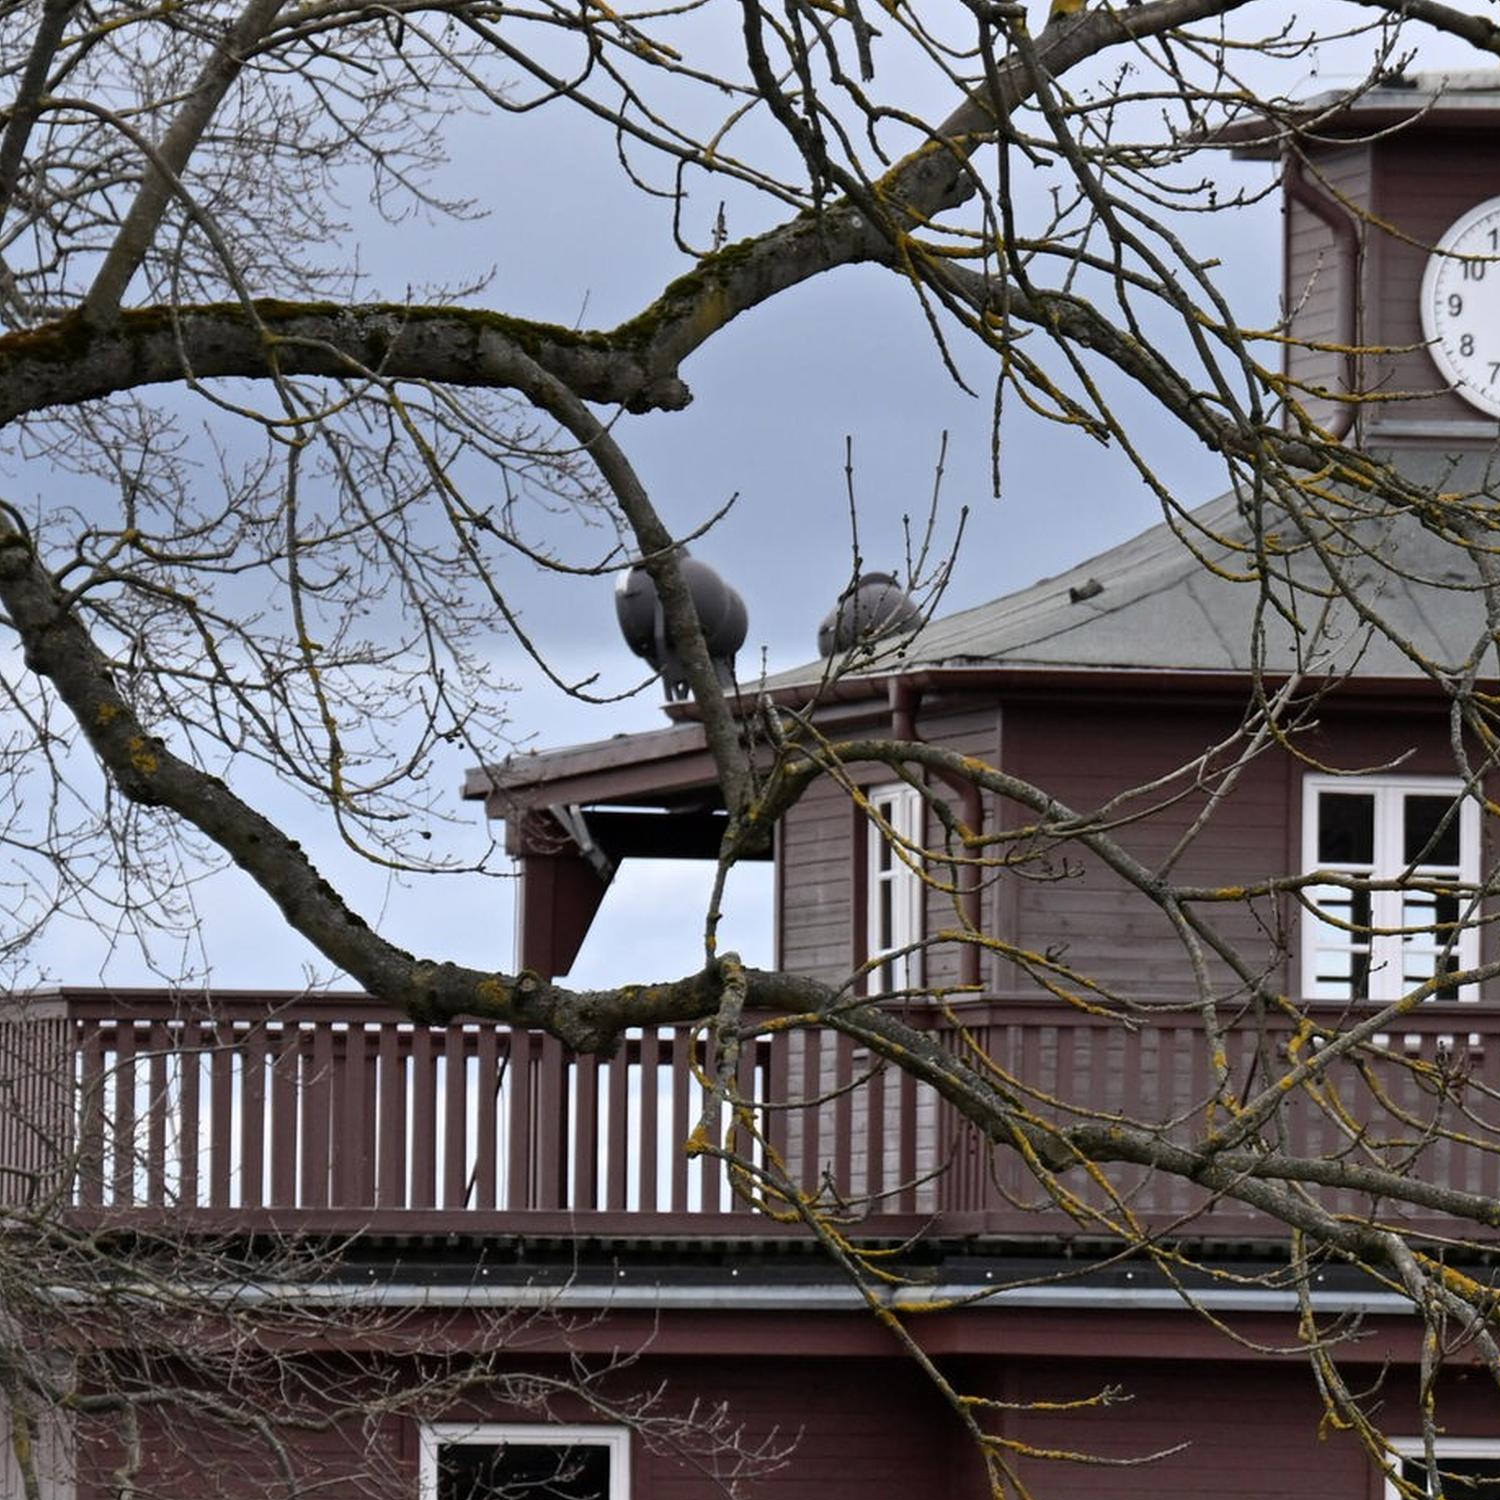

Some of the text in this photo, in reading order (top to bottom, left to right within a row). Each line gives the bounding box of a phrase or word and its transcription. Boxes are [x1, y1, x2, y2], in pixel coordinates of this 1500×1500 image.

[1460, 256, 1485, 281] 10
[1448, 294, 1463, 317] 9
[1459, 334, 1474, 357] 8
